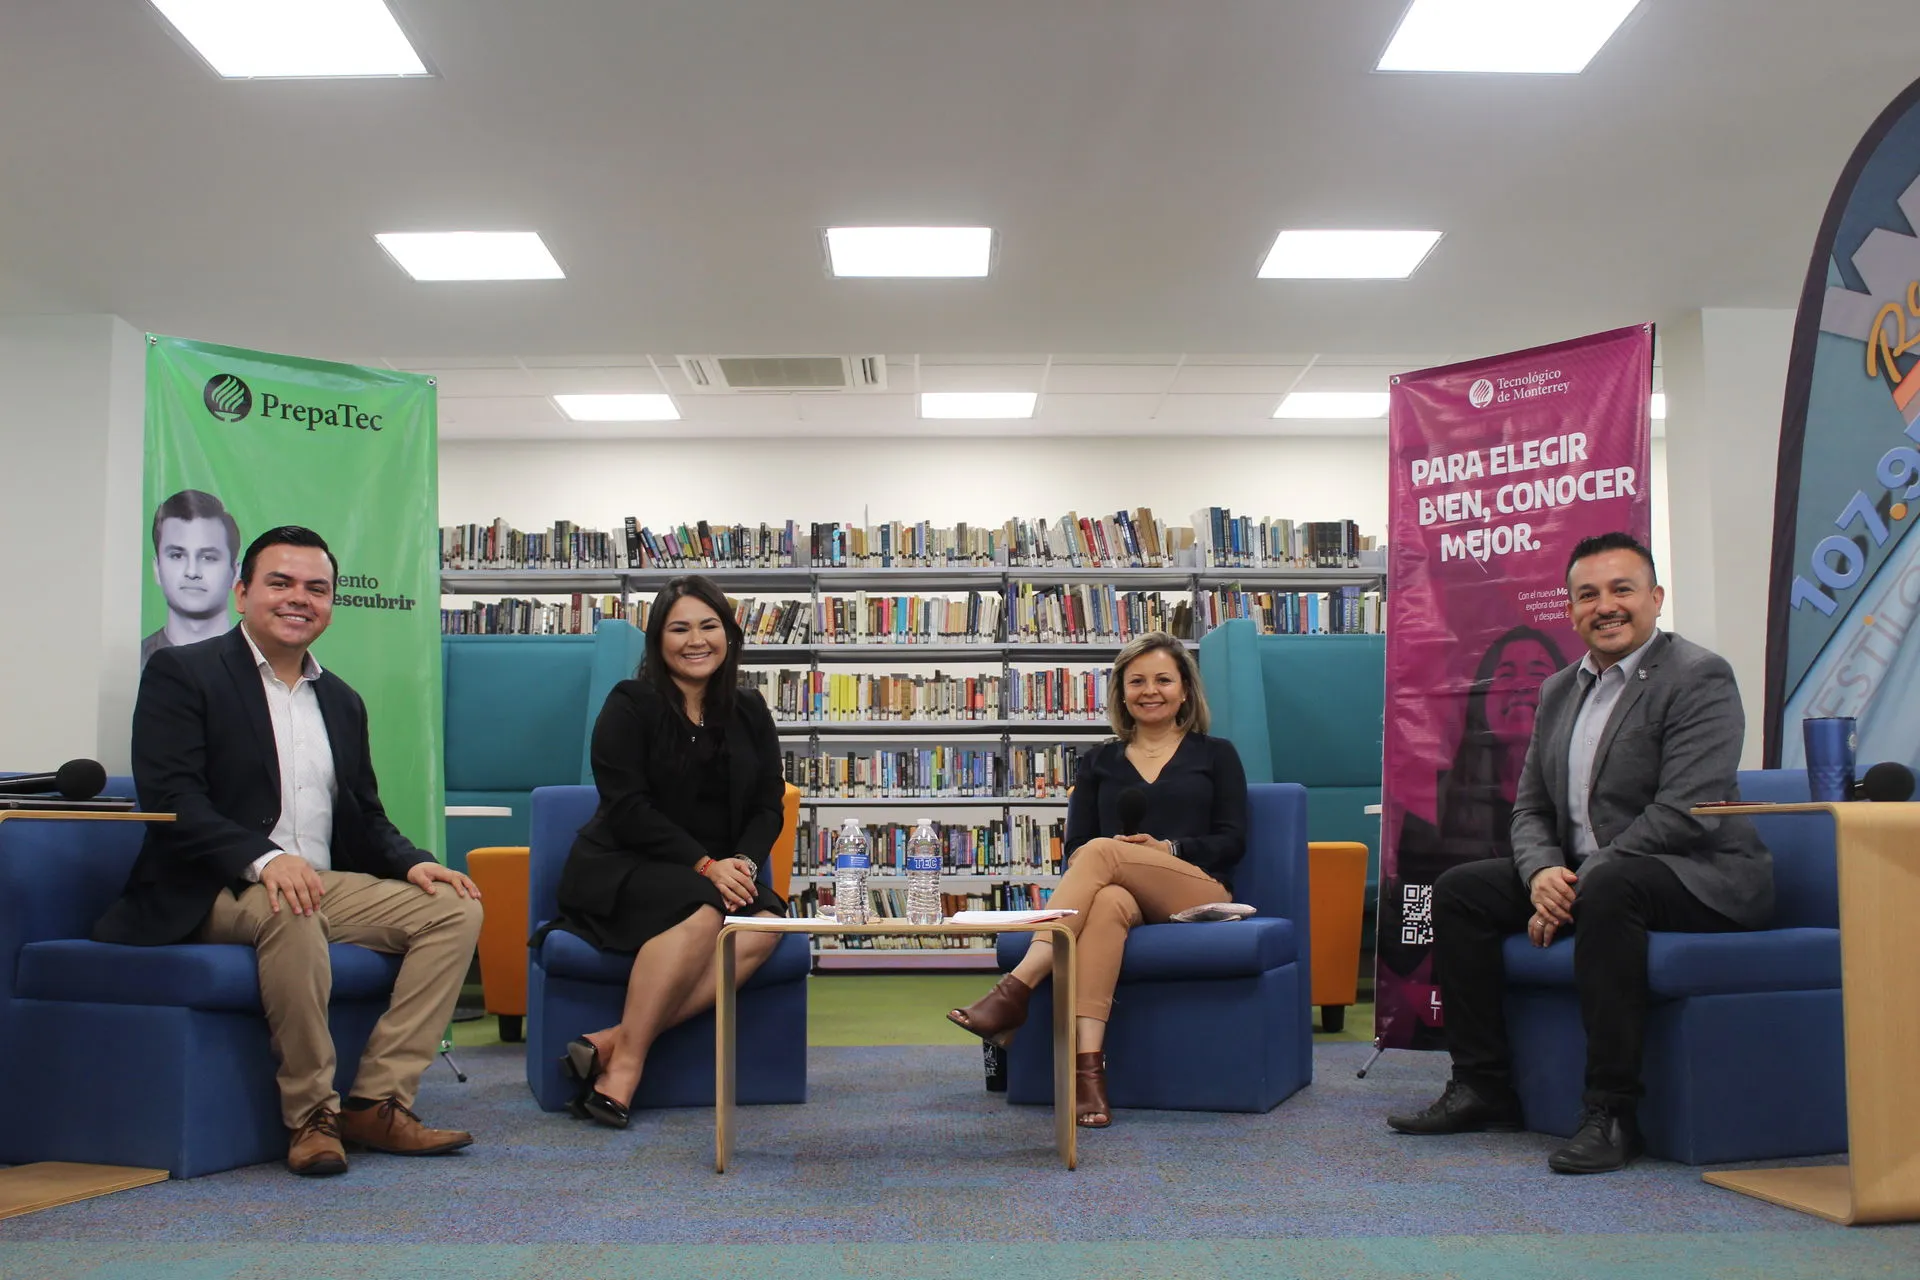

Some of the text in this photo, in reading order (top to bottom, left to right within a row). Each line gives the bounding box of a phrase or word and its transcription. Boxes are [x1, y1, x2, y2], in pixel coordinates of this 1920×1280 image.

[1497, 369, 1562, 390] Tecnológico
[1497, 382, 1570, 403] de Monterrey
[260, 392, 383, 431] PrepaTec
[1411, 432, 1588, 487] PARA ELEGIR
[1418, 466, 1637, 526] BIEN, CONOCER
[1440, 523, 1541, 563] MEJOR.
[337, 573, 379, 589] ento
[333, 593, 416, 610] escubrir
[914, 857, 937, 868] TEC
